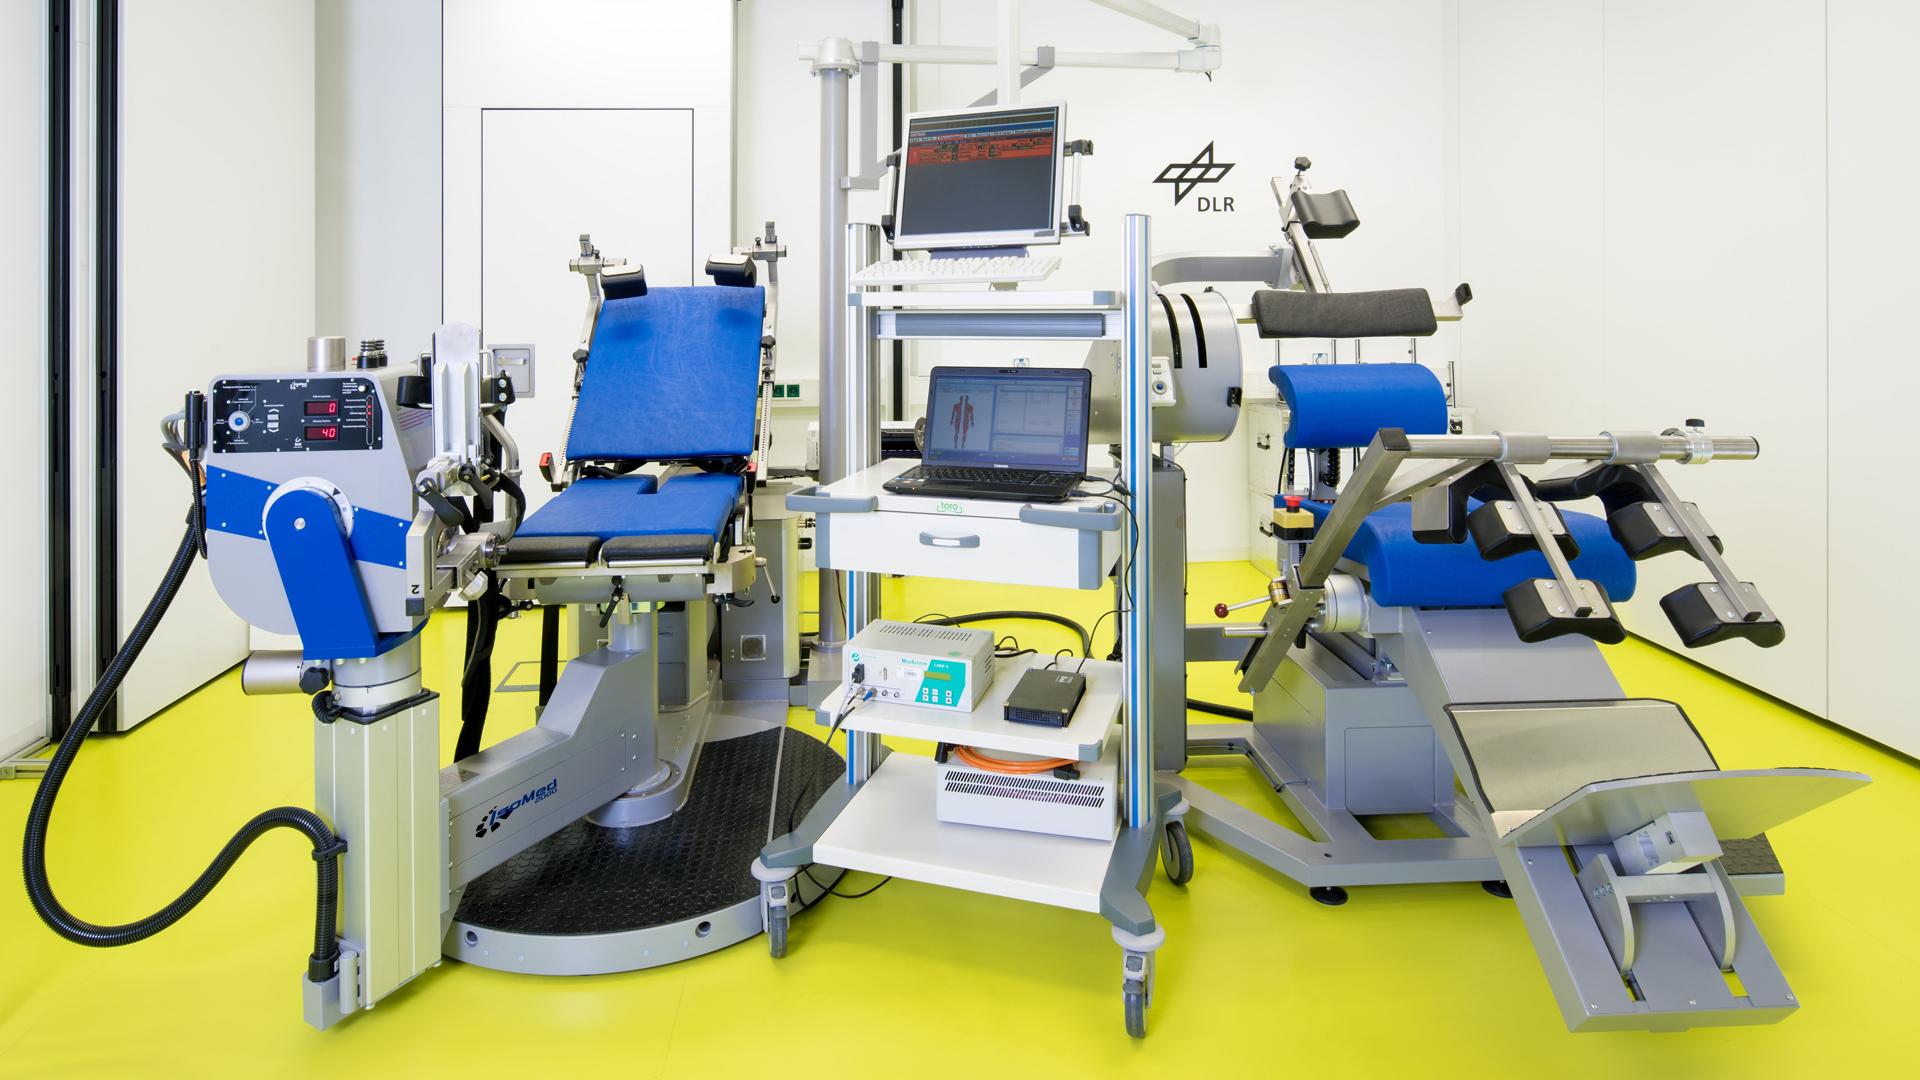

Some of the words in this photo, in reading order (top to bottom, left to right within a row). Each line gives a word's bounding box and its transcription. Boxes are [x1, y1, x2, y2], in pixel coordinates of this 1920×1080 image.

[1197, 196, 1235, 212] DLR
[328, 403, 336, 413] 0
[322, 428, 336, 438] 40
[940, 501, 959, 510] toro
[411, 584, 420, 595] 2
